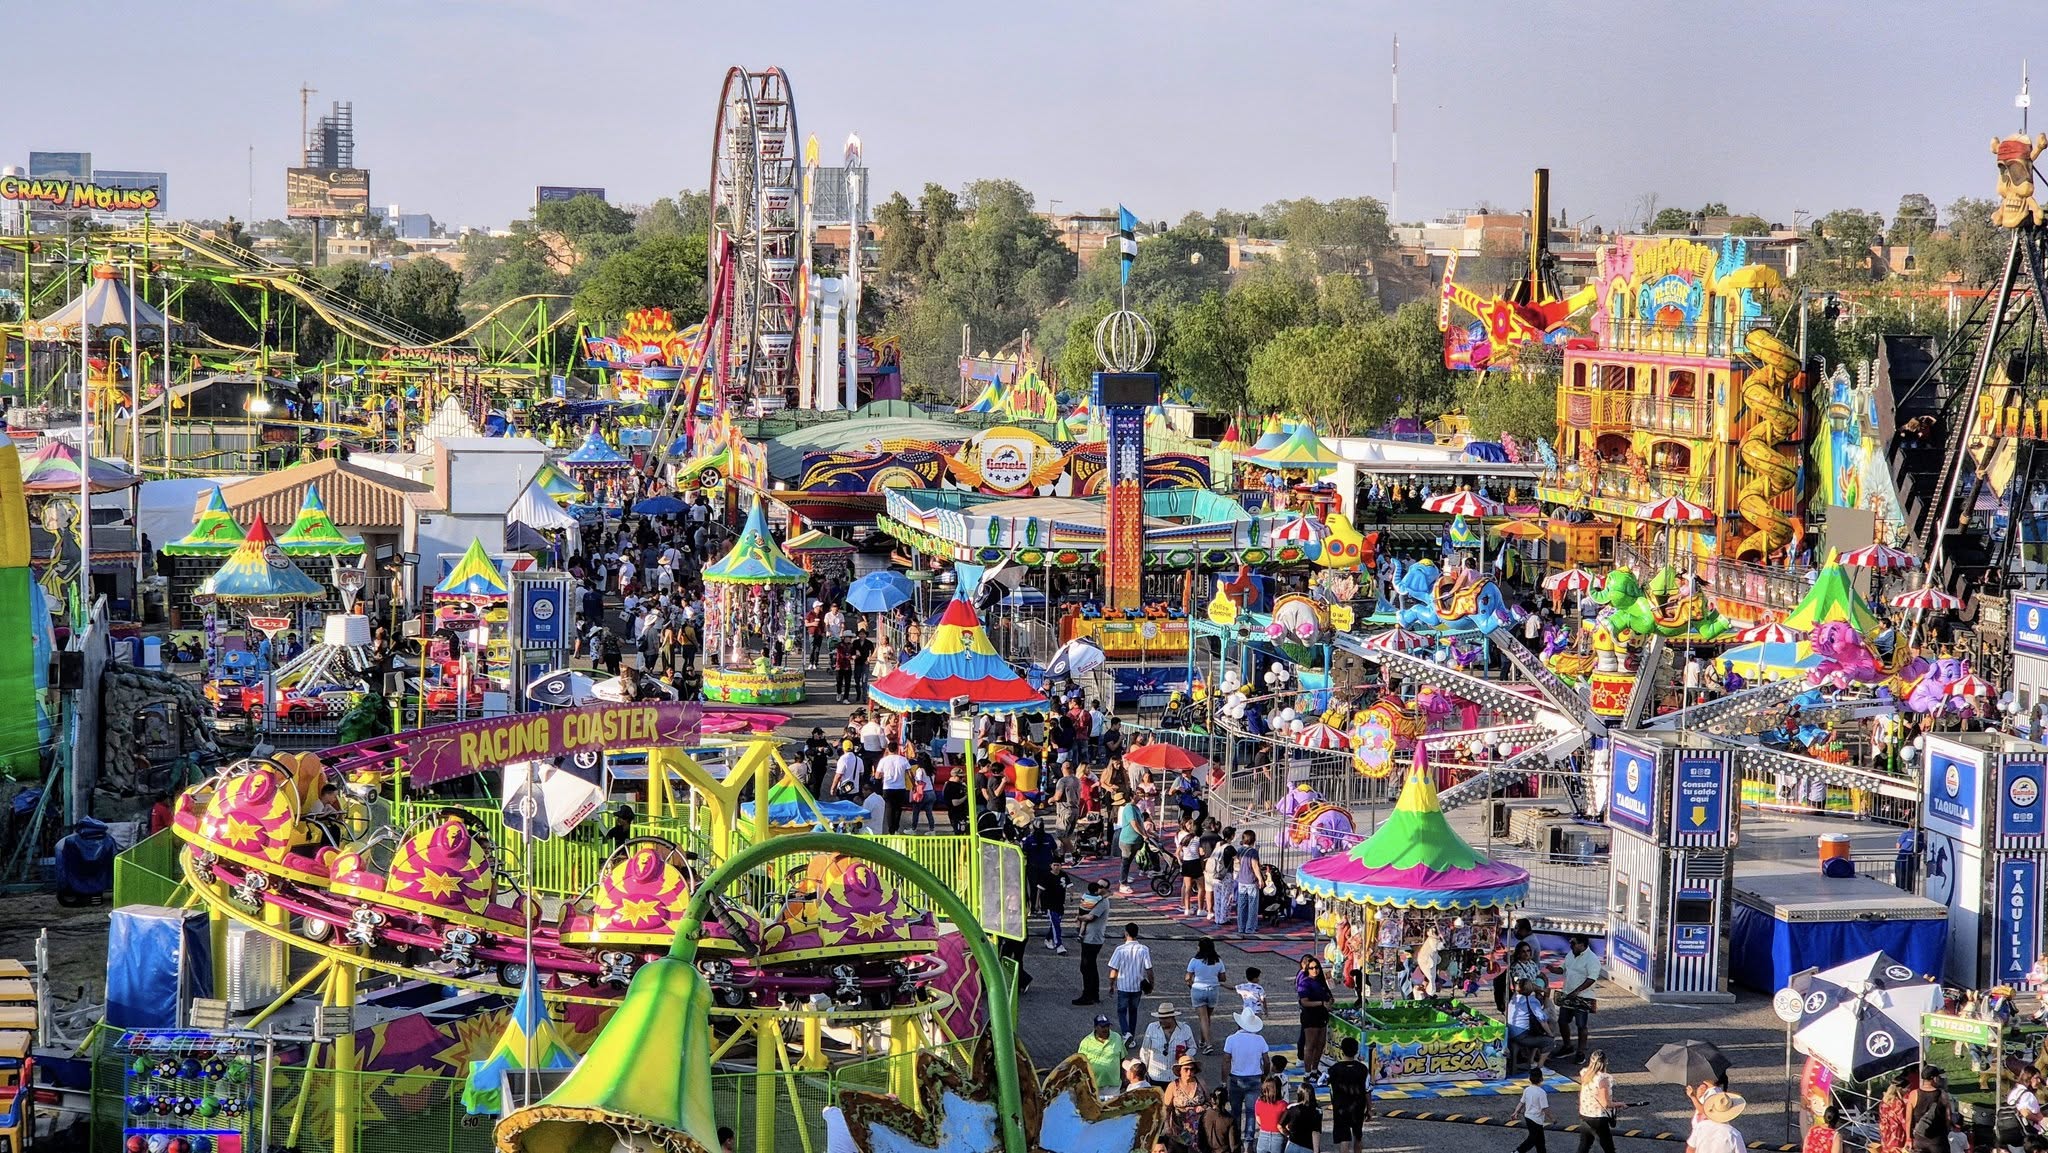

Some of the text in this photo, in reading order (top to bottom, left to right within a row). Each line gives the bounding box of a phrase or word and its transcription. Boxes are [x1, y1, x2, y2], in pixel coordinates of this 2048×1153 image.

[0, 176, 70, 205] CRAZY
[254, 619, 284, 629] Cars
[446, 621, 475, 629] Cars
[460, 707, 660, 770] RACING COASTER
[1693, 788, 1717, 796] saldo
[1616, 792, 1647, 816] TAQUILLA
[1934, 798, 1970, 821] TAQUILLA
[2009, 869, 2025, 972] TAQUILLA
[1930, 1018, 1981, 1034] ENTRADA
[1417, 1039, 1477, 1056] JUEGO
[1402, 1052, 1489, 1075] DE PESCA
